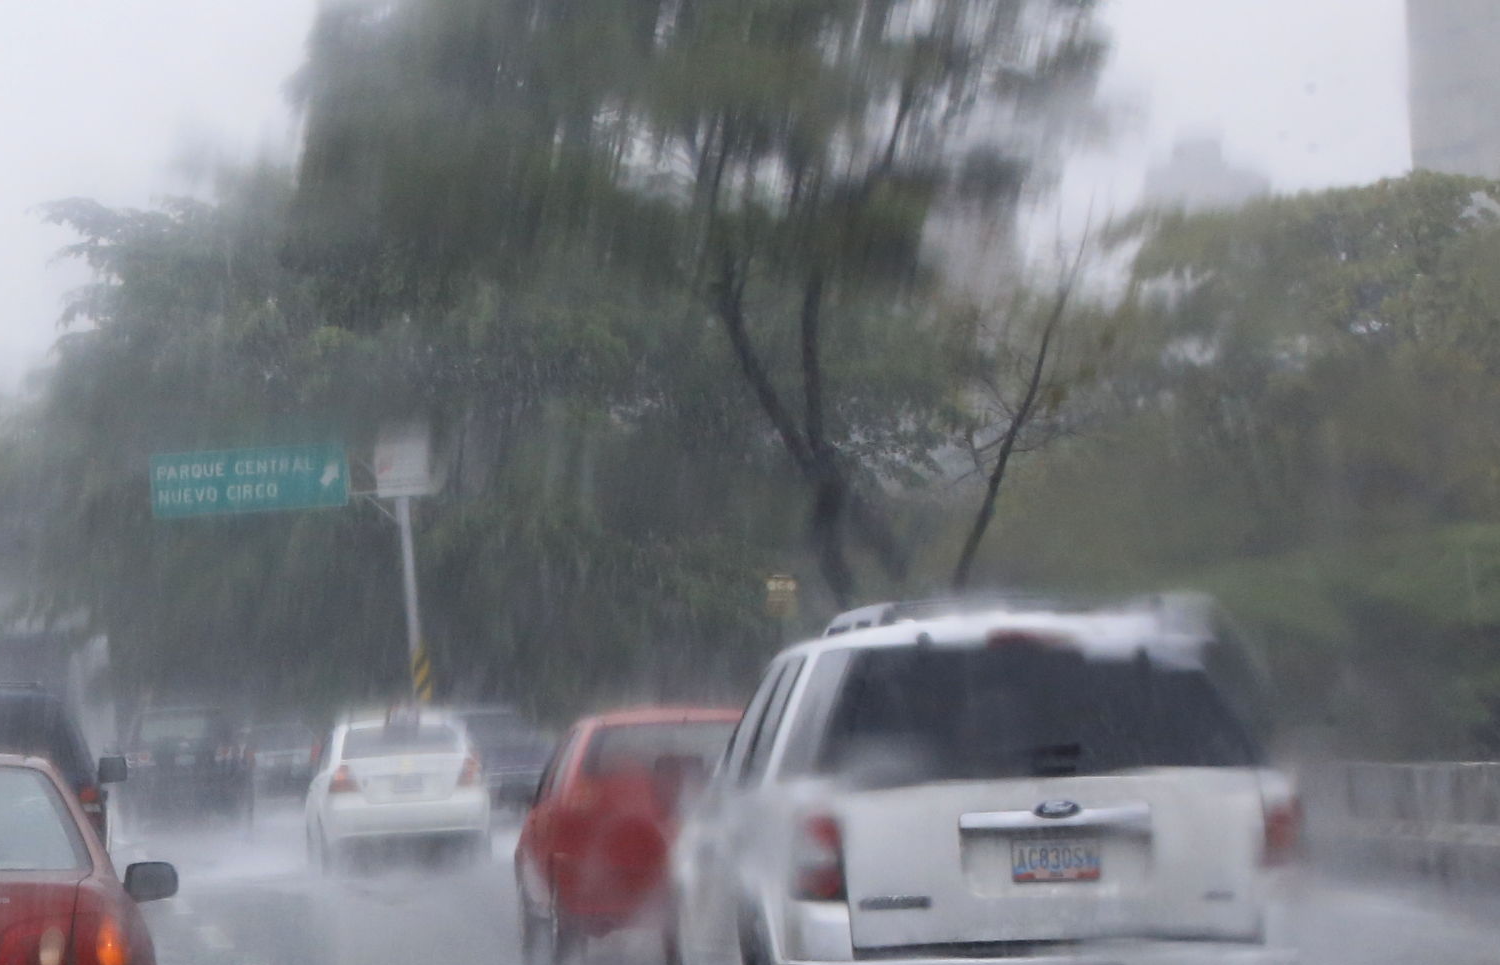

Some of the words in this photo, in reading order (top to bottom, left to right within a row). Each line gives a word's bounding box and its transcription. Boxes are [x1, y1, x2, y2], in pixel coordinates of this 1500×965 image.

[156, 462, 225, 481] PARQUE
[234, 456, 315, 476] CENTRAL
[157, 487, 218, 506] NUEVO
[226, 482, 279, 501] CIRCO
